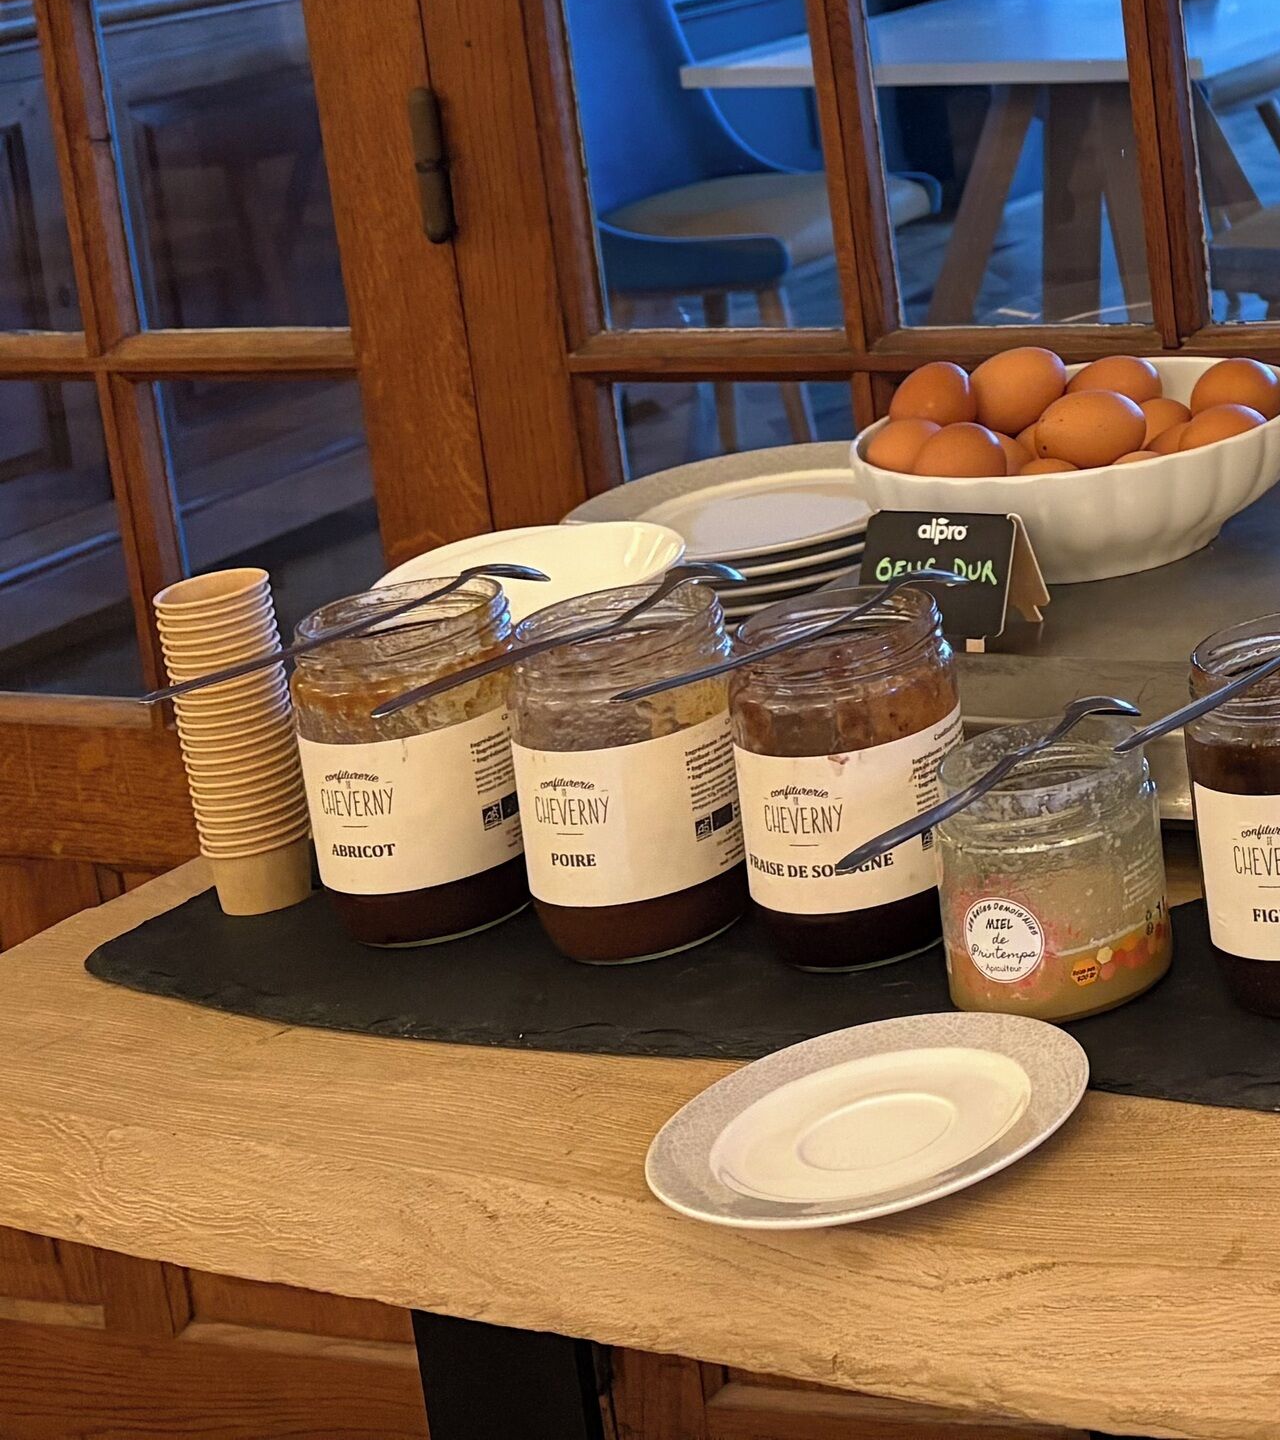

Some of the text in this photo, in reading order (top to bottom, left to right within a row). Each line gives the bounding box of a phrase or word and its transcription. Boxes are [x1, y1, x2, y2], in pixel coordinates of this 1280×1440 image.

[917, 517, 968, 545] alpro
[953, 557, 998, 586] DUR
[324, 769, 379, 784] confiturerie
[540, 777, 595, 791] confiturerie
[770, 785, 829, 799] confiturerie
[320, 787, 394, 817] CHEVERNY
[534, 795, 610, 826] CHEVERNY
[764, 803, 843, 835] CHEVERNY
[331, 843, 396, 858] ABRICOT
[551, 852, 597, 867] POIRE
[749, 853, 785, 877] FRAISE
[788, 865, 809, 878] DE
[985, 918, 1014, 930] MIEL
[992, 932, 1010, 945] de
[971, 943, 1038, 964] Printemps
